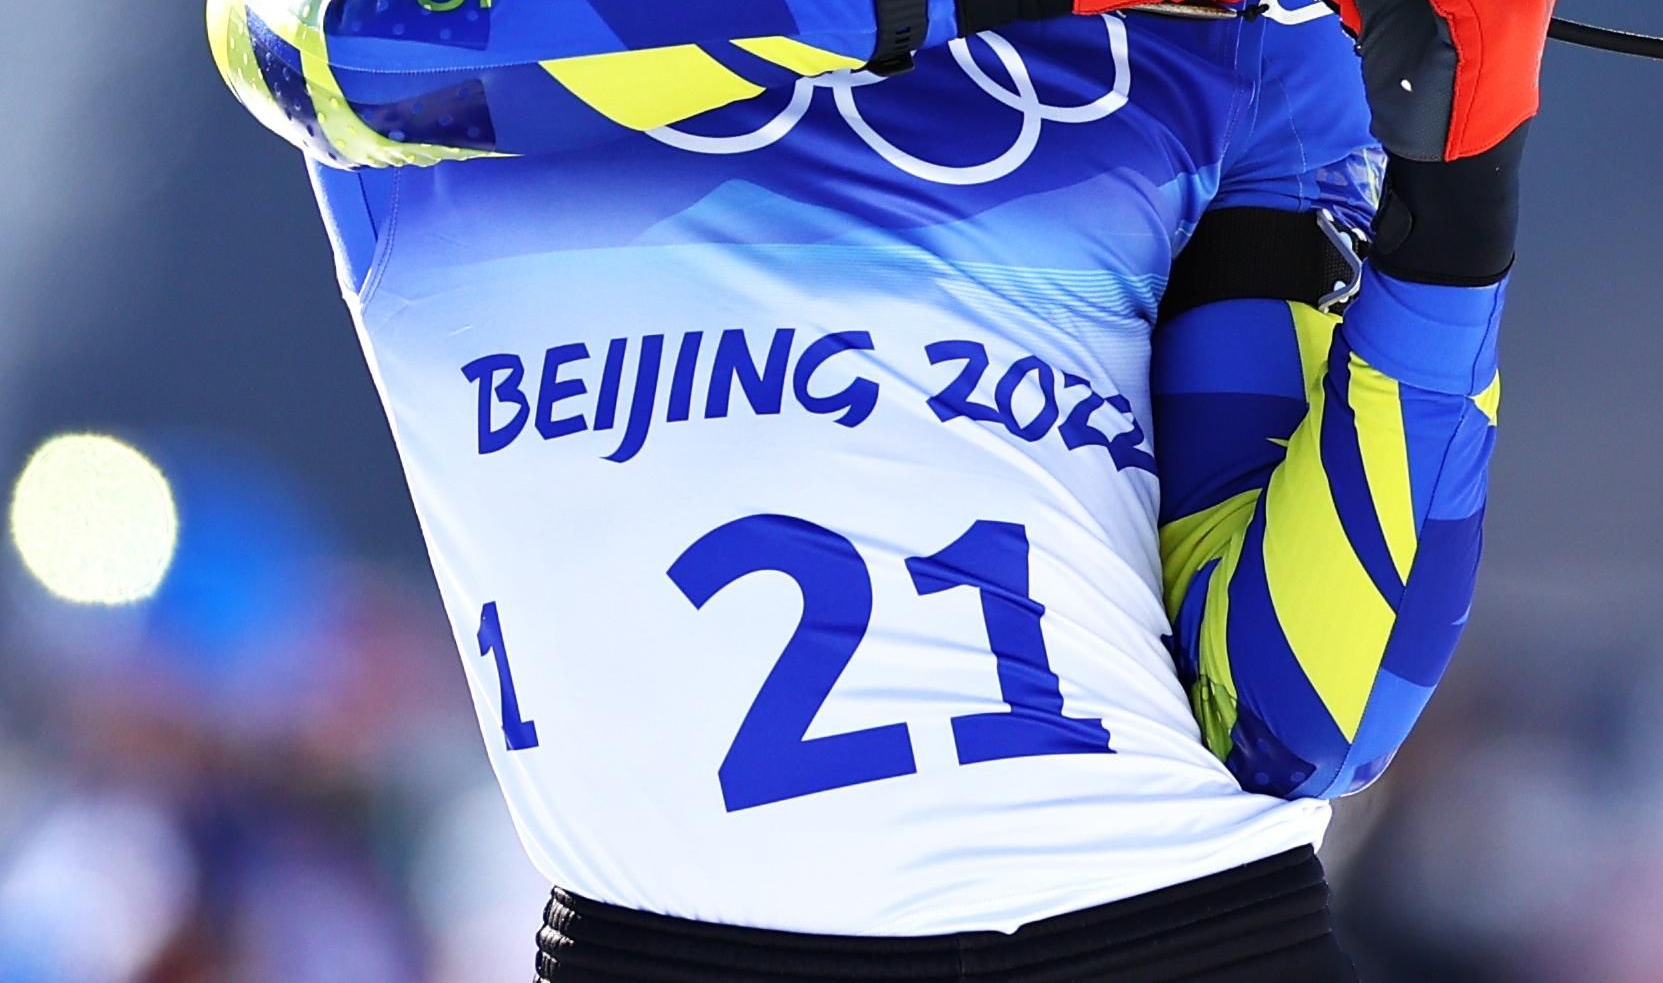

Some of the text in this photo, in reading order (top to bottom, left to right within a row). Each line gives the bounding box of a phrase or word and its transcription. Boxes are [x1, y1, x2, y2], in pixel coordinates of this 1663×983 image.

[460, 327, 1159, 474] BEIJING 2022
[665, 512, 1118, 813] 21
